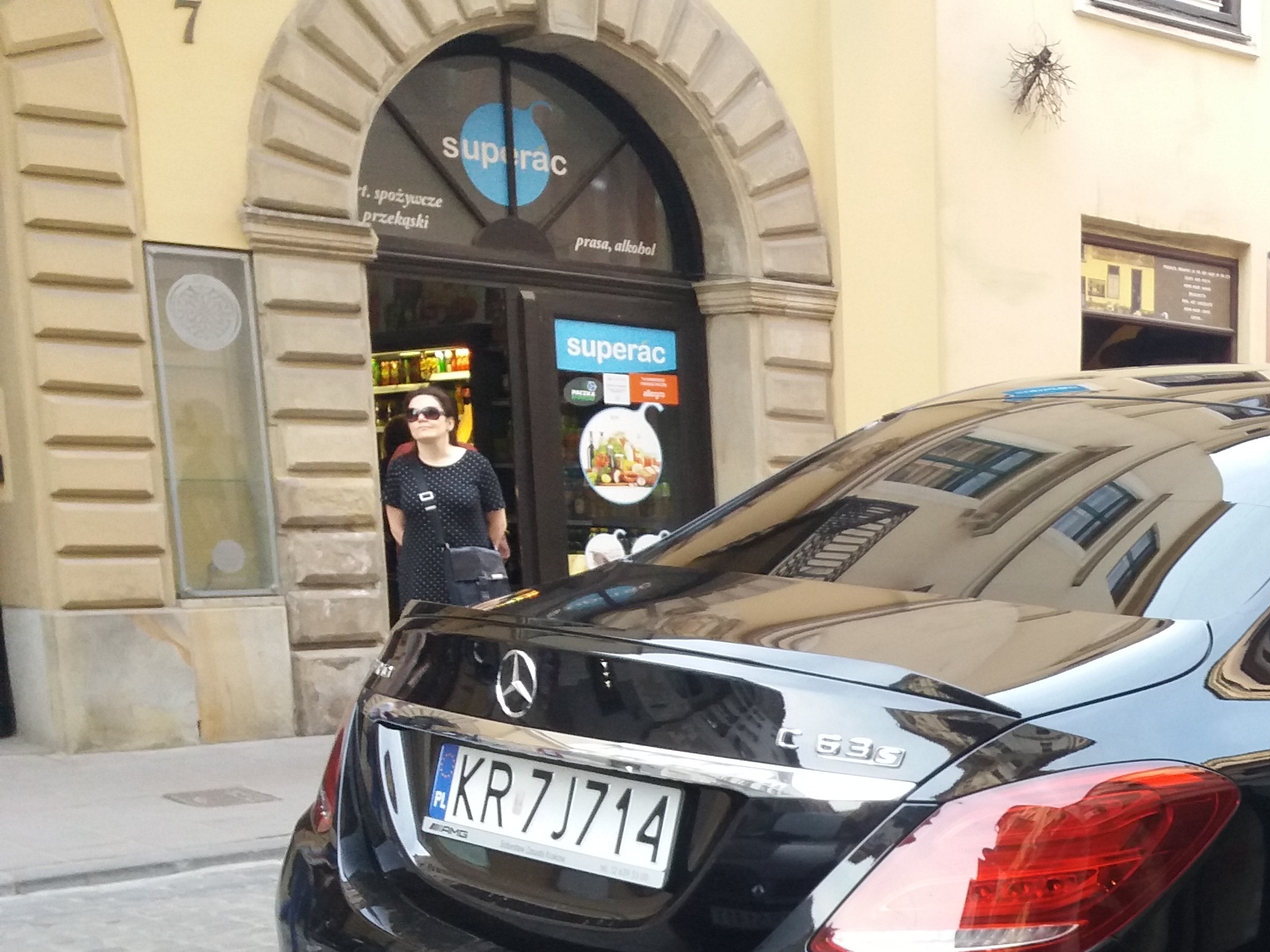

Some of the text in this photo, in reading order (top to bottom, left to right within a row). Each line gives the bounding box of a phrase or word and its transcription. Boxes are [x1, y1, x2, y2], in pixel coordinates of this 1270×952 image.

[174, 0, 202, 44] 7
[373, 188, 443, 209] spożywcze
[362, 210, 430, 230] przekąski
[574, 237, 657, 256] prasa, alkohol
[433, 790, 447, 809] PL
[453, 754, 669, 863] KR 7J714
[441, 825, 469, 839] AMG
